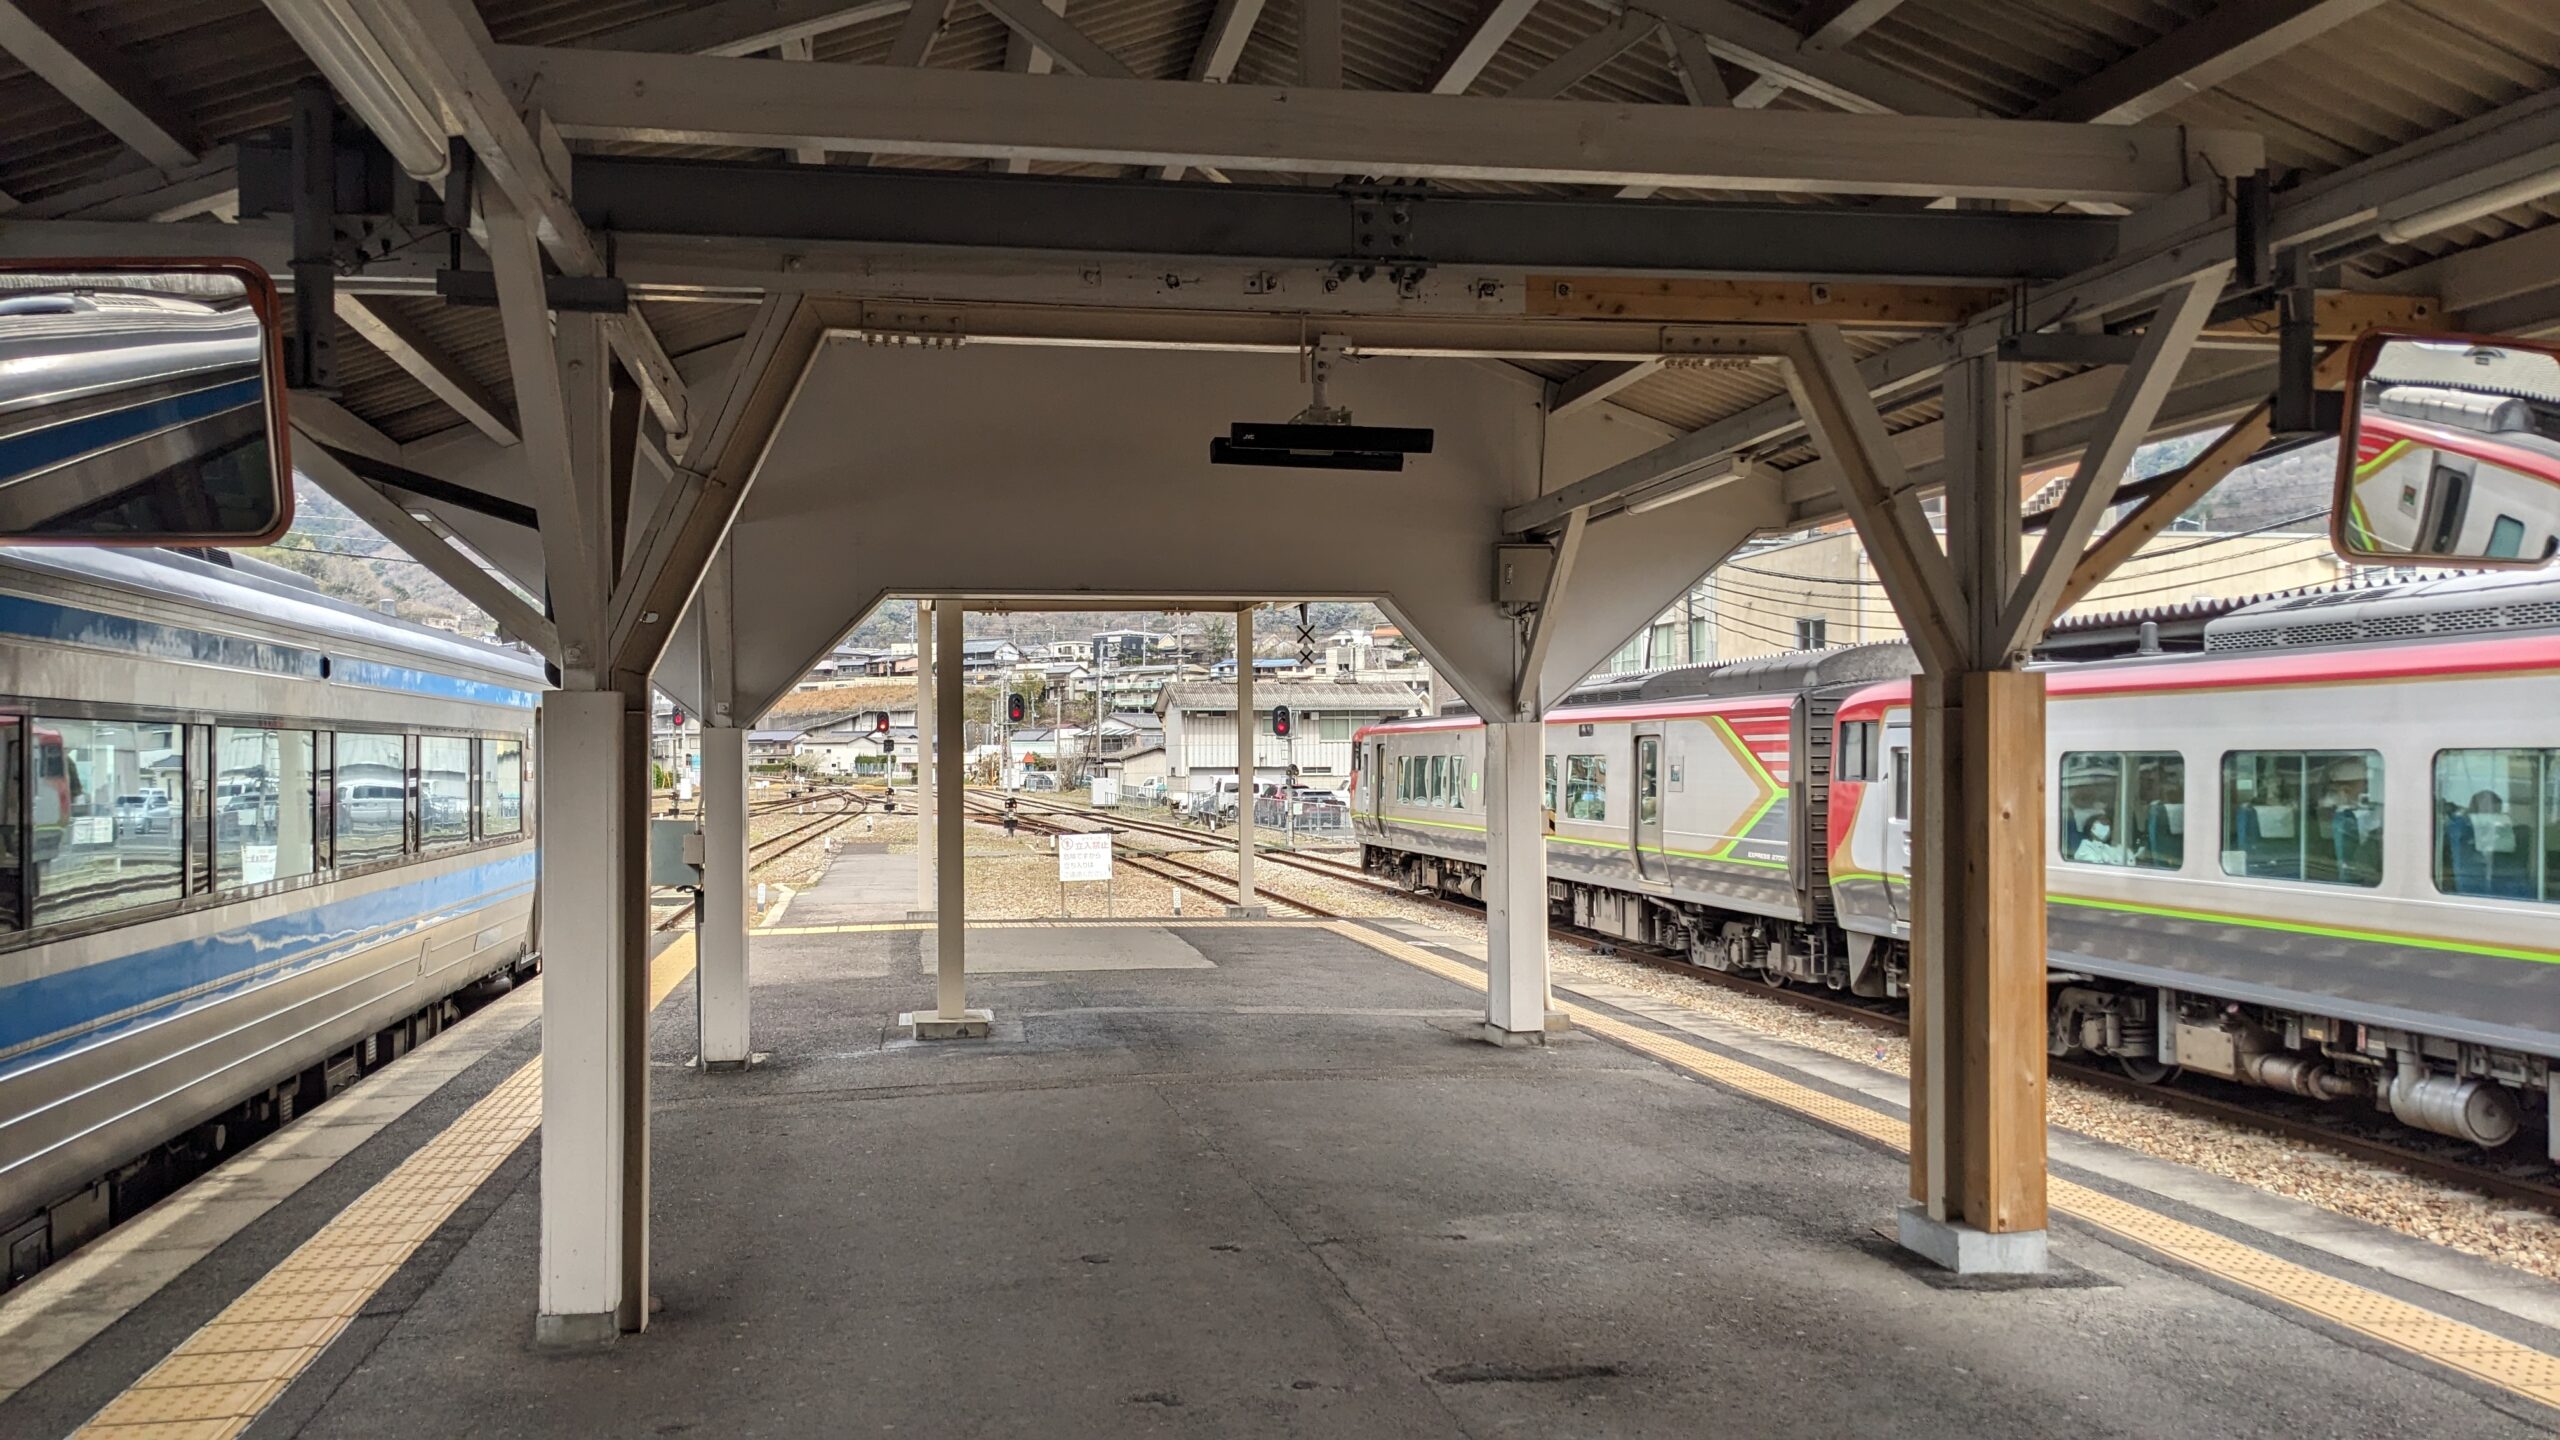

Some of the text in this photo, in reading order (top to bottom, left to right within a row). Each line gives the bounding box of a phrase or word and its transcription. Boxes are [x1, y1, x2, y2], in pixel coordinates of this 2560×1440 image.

[1075, 841, 1109, 849] 立入禁止
[1063, 852, 1101, 860] 危険ですから
[1748, 851, 1770, 860] EXPRESS
[1063, 861, 1094, 870] 立ち入りは
